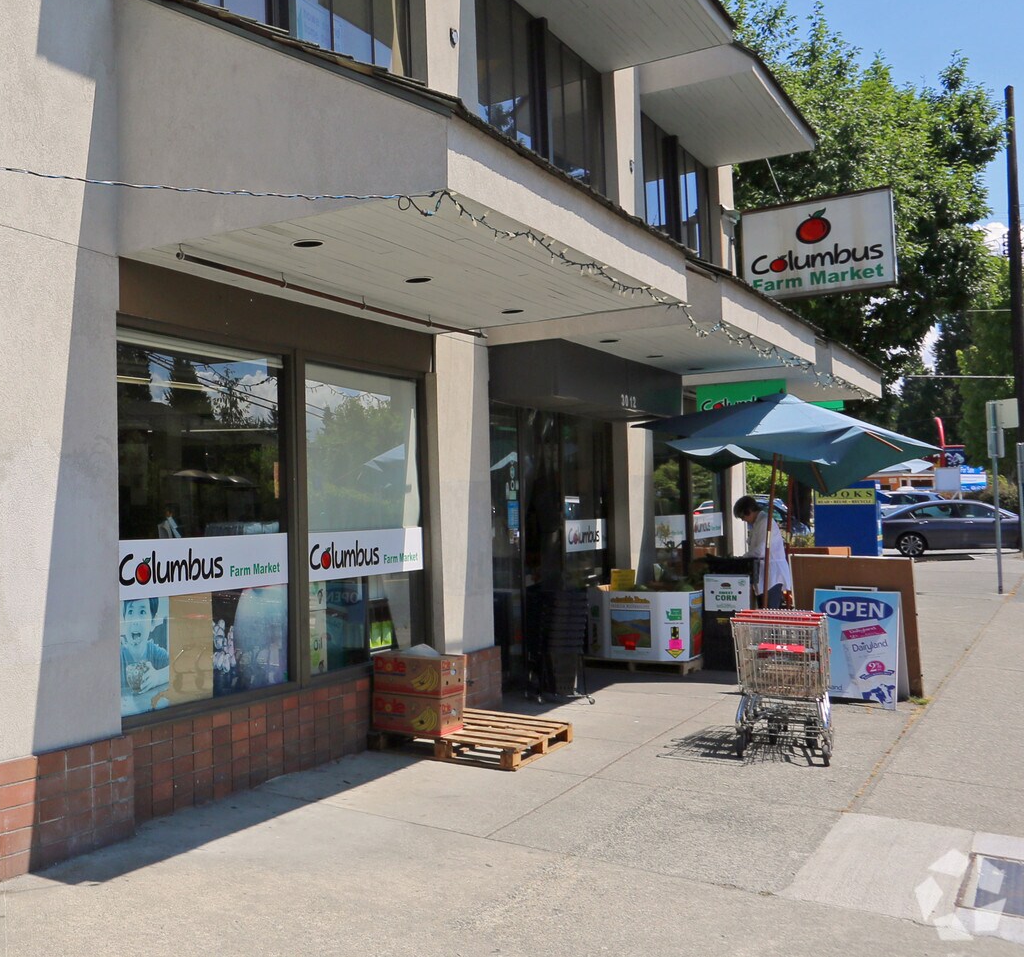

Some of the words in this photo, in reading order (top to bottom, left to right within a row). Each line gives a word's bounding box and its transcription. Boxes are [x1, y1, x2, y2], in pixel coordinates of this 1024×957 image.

[751, 243, 884, 275] Columbus
[753, 276, 803, 292] Farm
[810, 263, 884, 285] Market
[568, 526, 600, 544] Columbus
[119, 548, 224, 586] Columbus
[230, 565, 251, 577] Farm
[253, 562, 280, 575] Market
[310, 540, 380, 571] Columbus
[383, 554, 398, 564] Farm
[825, 601, 885, 618] OPEN
[852, 640, 888, 653] Dairyland
